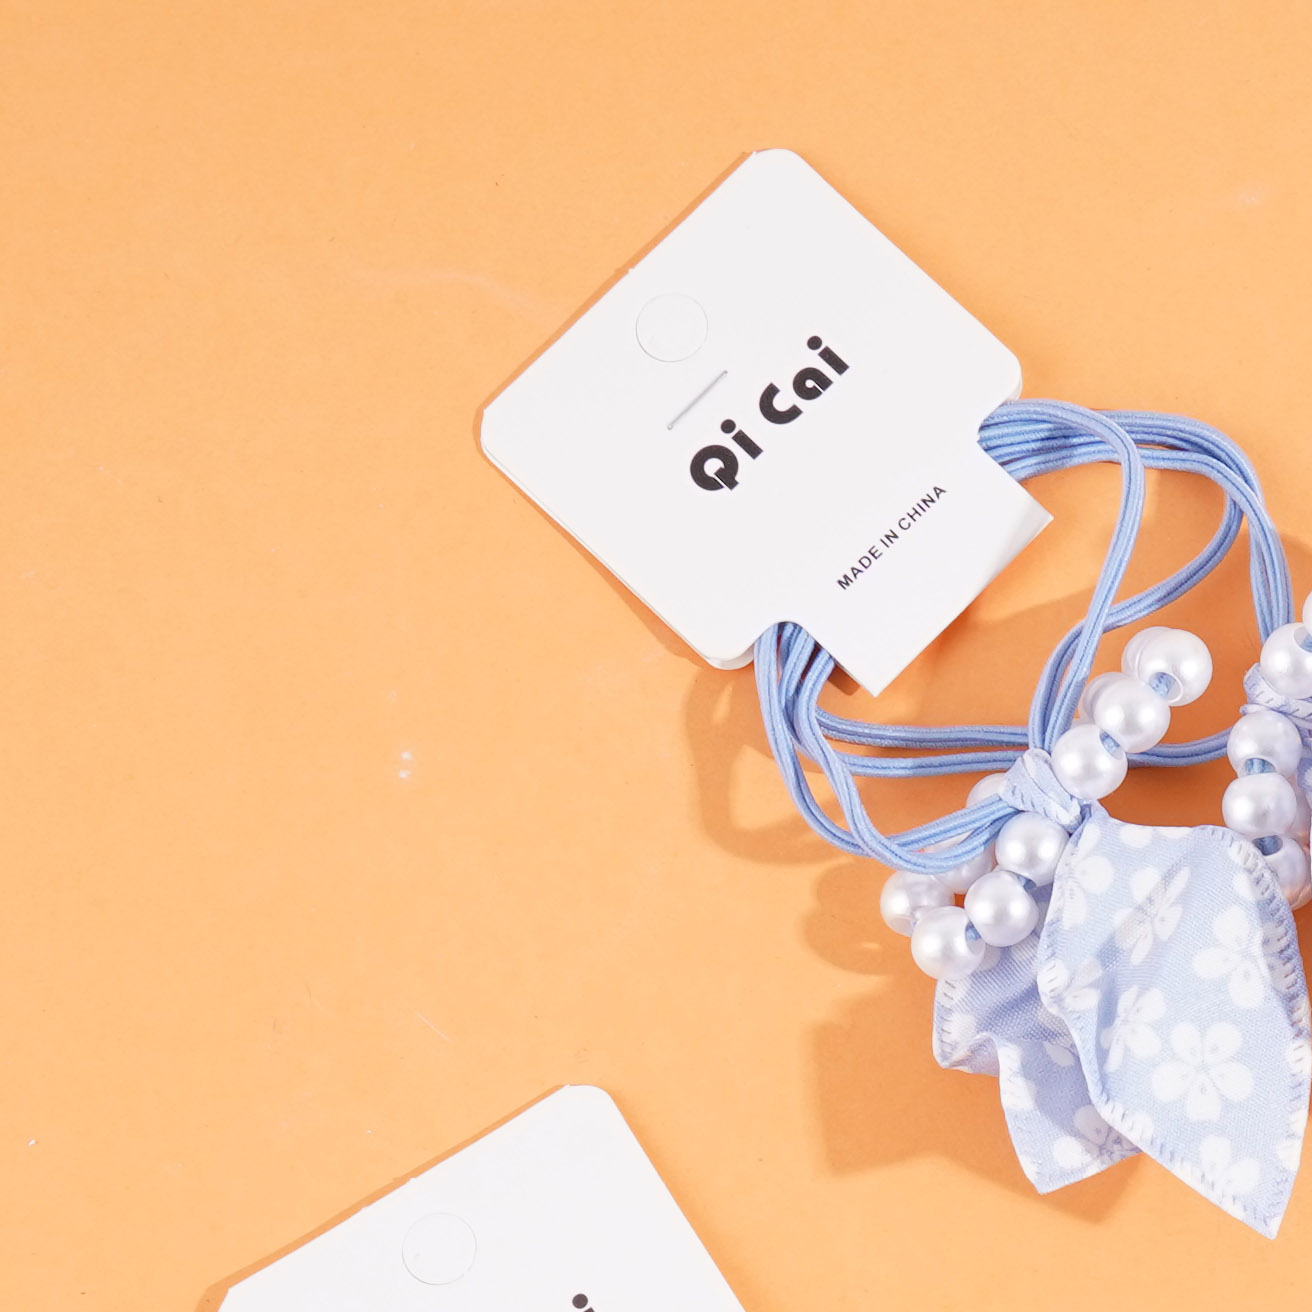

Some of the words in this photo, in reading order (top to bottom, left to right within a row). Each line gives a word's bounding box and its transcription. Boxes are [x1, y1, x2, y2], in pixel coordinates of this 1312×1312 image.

[689, 418, 764, 492] Qi
[758, 335, 850, 425] Cai
[836, 544, 883, 590] MADE
[879, 528, 900, 549] IN
[897, 486, 947, 531] CHINA
